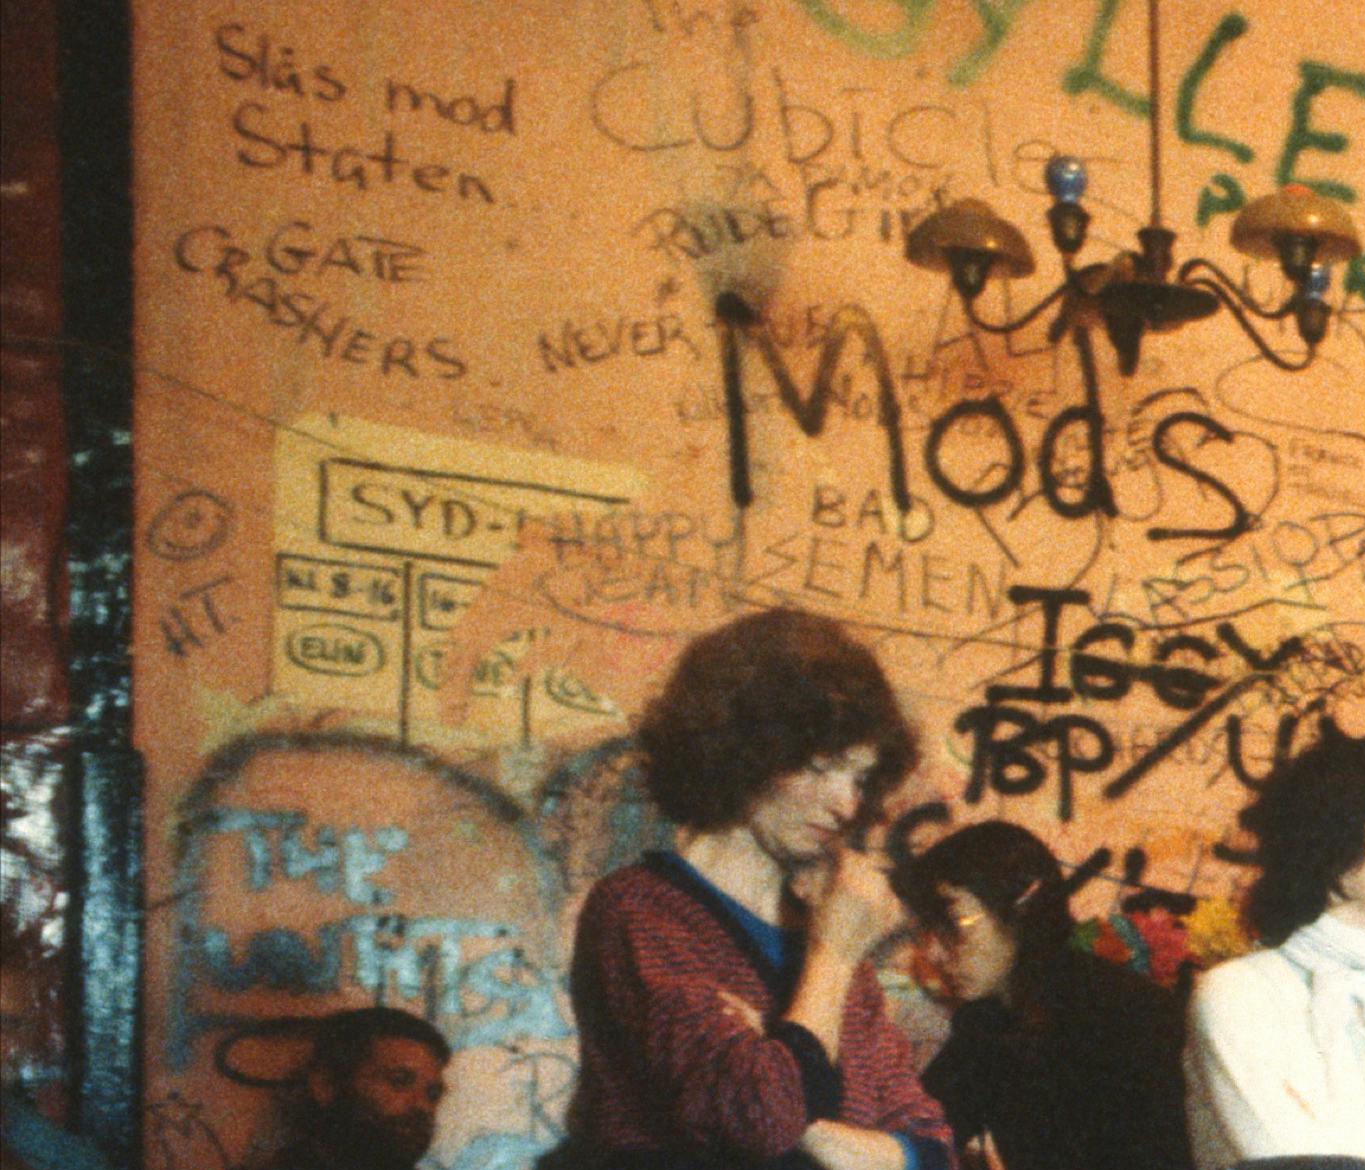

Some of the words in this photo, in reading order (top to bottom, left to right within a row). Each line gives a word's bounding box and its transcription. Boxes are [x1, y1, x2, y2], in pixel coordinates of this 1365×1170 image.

[387, 80, 517, 136] mod
[232, 104, 496, 204] Staten
[536, 314, 700, 374] NEVER
[716, 290, 1244, 546] Mods
